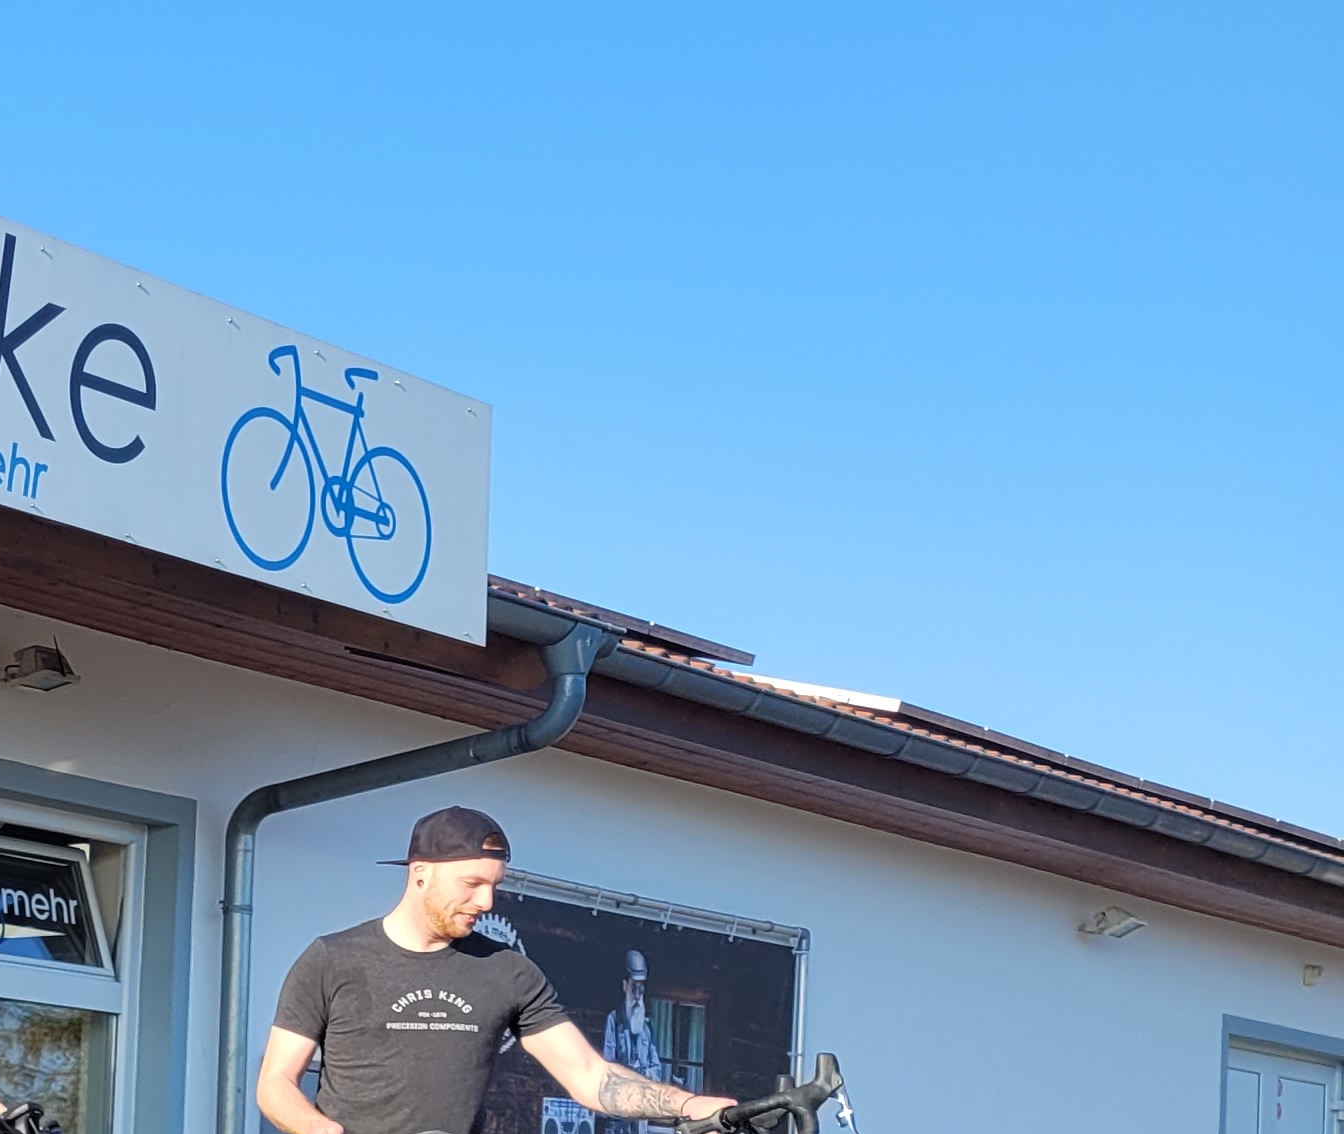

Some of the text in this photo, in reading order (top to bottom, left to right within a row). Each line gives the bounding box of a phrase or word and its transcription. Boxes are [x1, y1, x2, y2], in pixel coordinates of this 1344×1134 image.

[391, 989, 473, 1014] CHRIS KING
[429, 1022, 479, 1033] COMPONENTS
